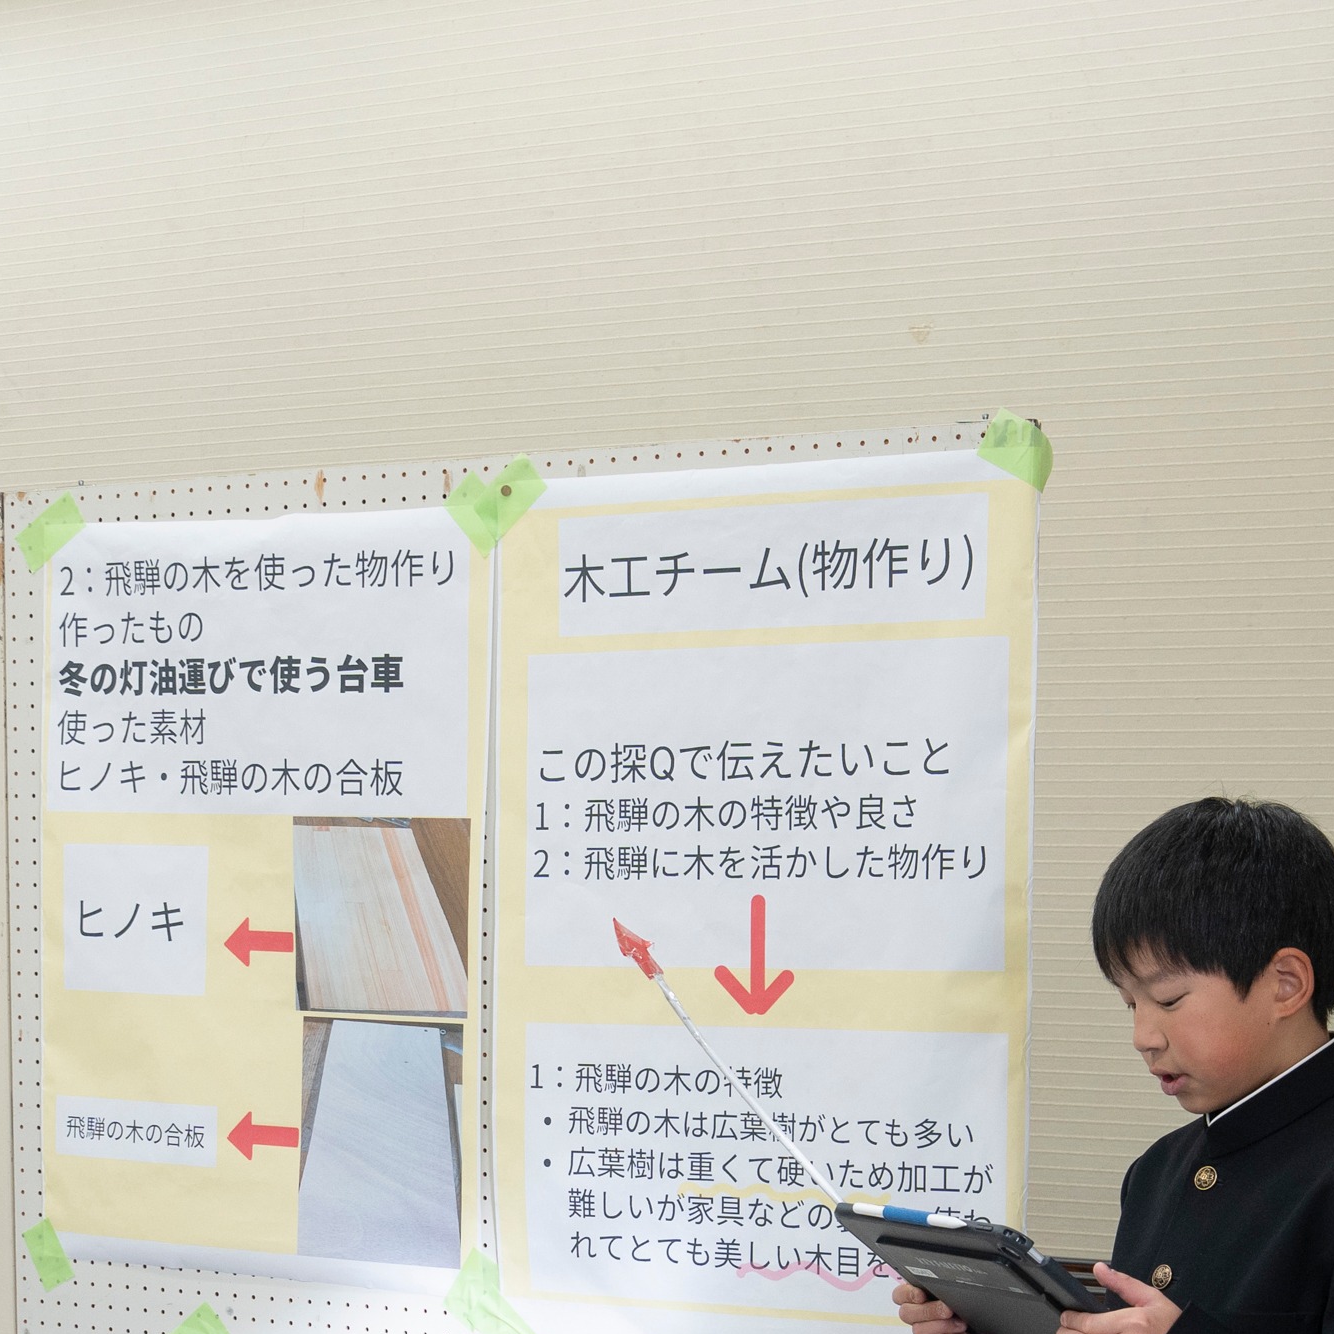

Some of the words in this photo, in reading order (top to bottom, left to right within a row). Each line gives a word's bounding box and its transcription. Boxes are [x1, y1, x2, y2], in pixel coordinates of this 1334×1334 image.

[563, 533, 974, 603] 木工チーム(物作り)
[58, 610, 204, 648] 作ったもの
[58, 653, 404, 697] 冬の灯油運びで使う台車
[57, 707, 207, 746] 使った素材
[60, 757, 403, 797] ヒノキ・飛騨の木の合板
[539, 737, 950, 784] この探Qで伝えたいこと
[79, 899, 184, 942] ヒノキ
[66, 1115, 205, 1149] 飛騨の木の合板
